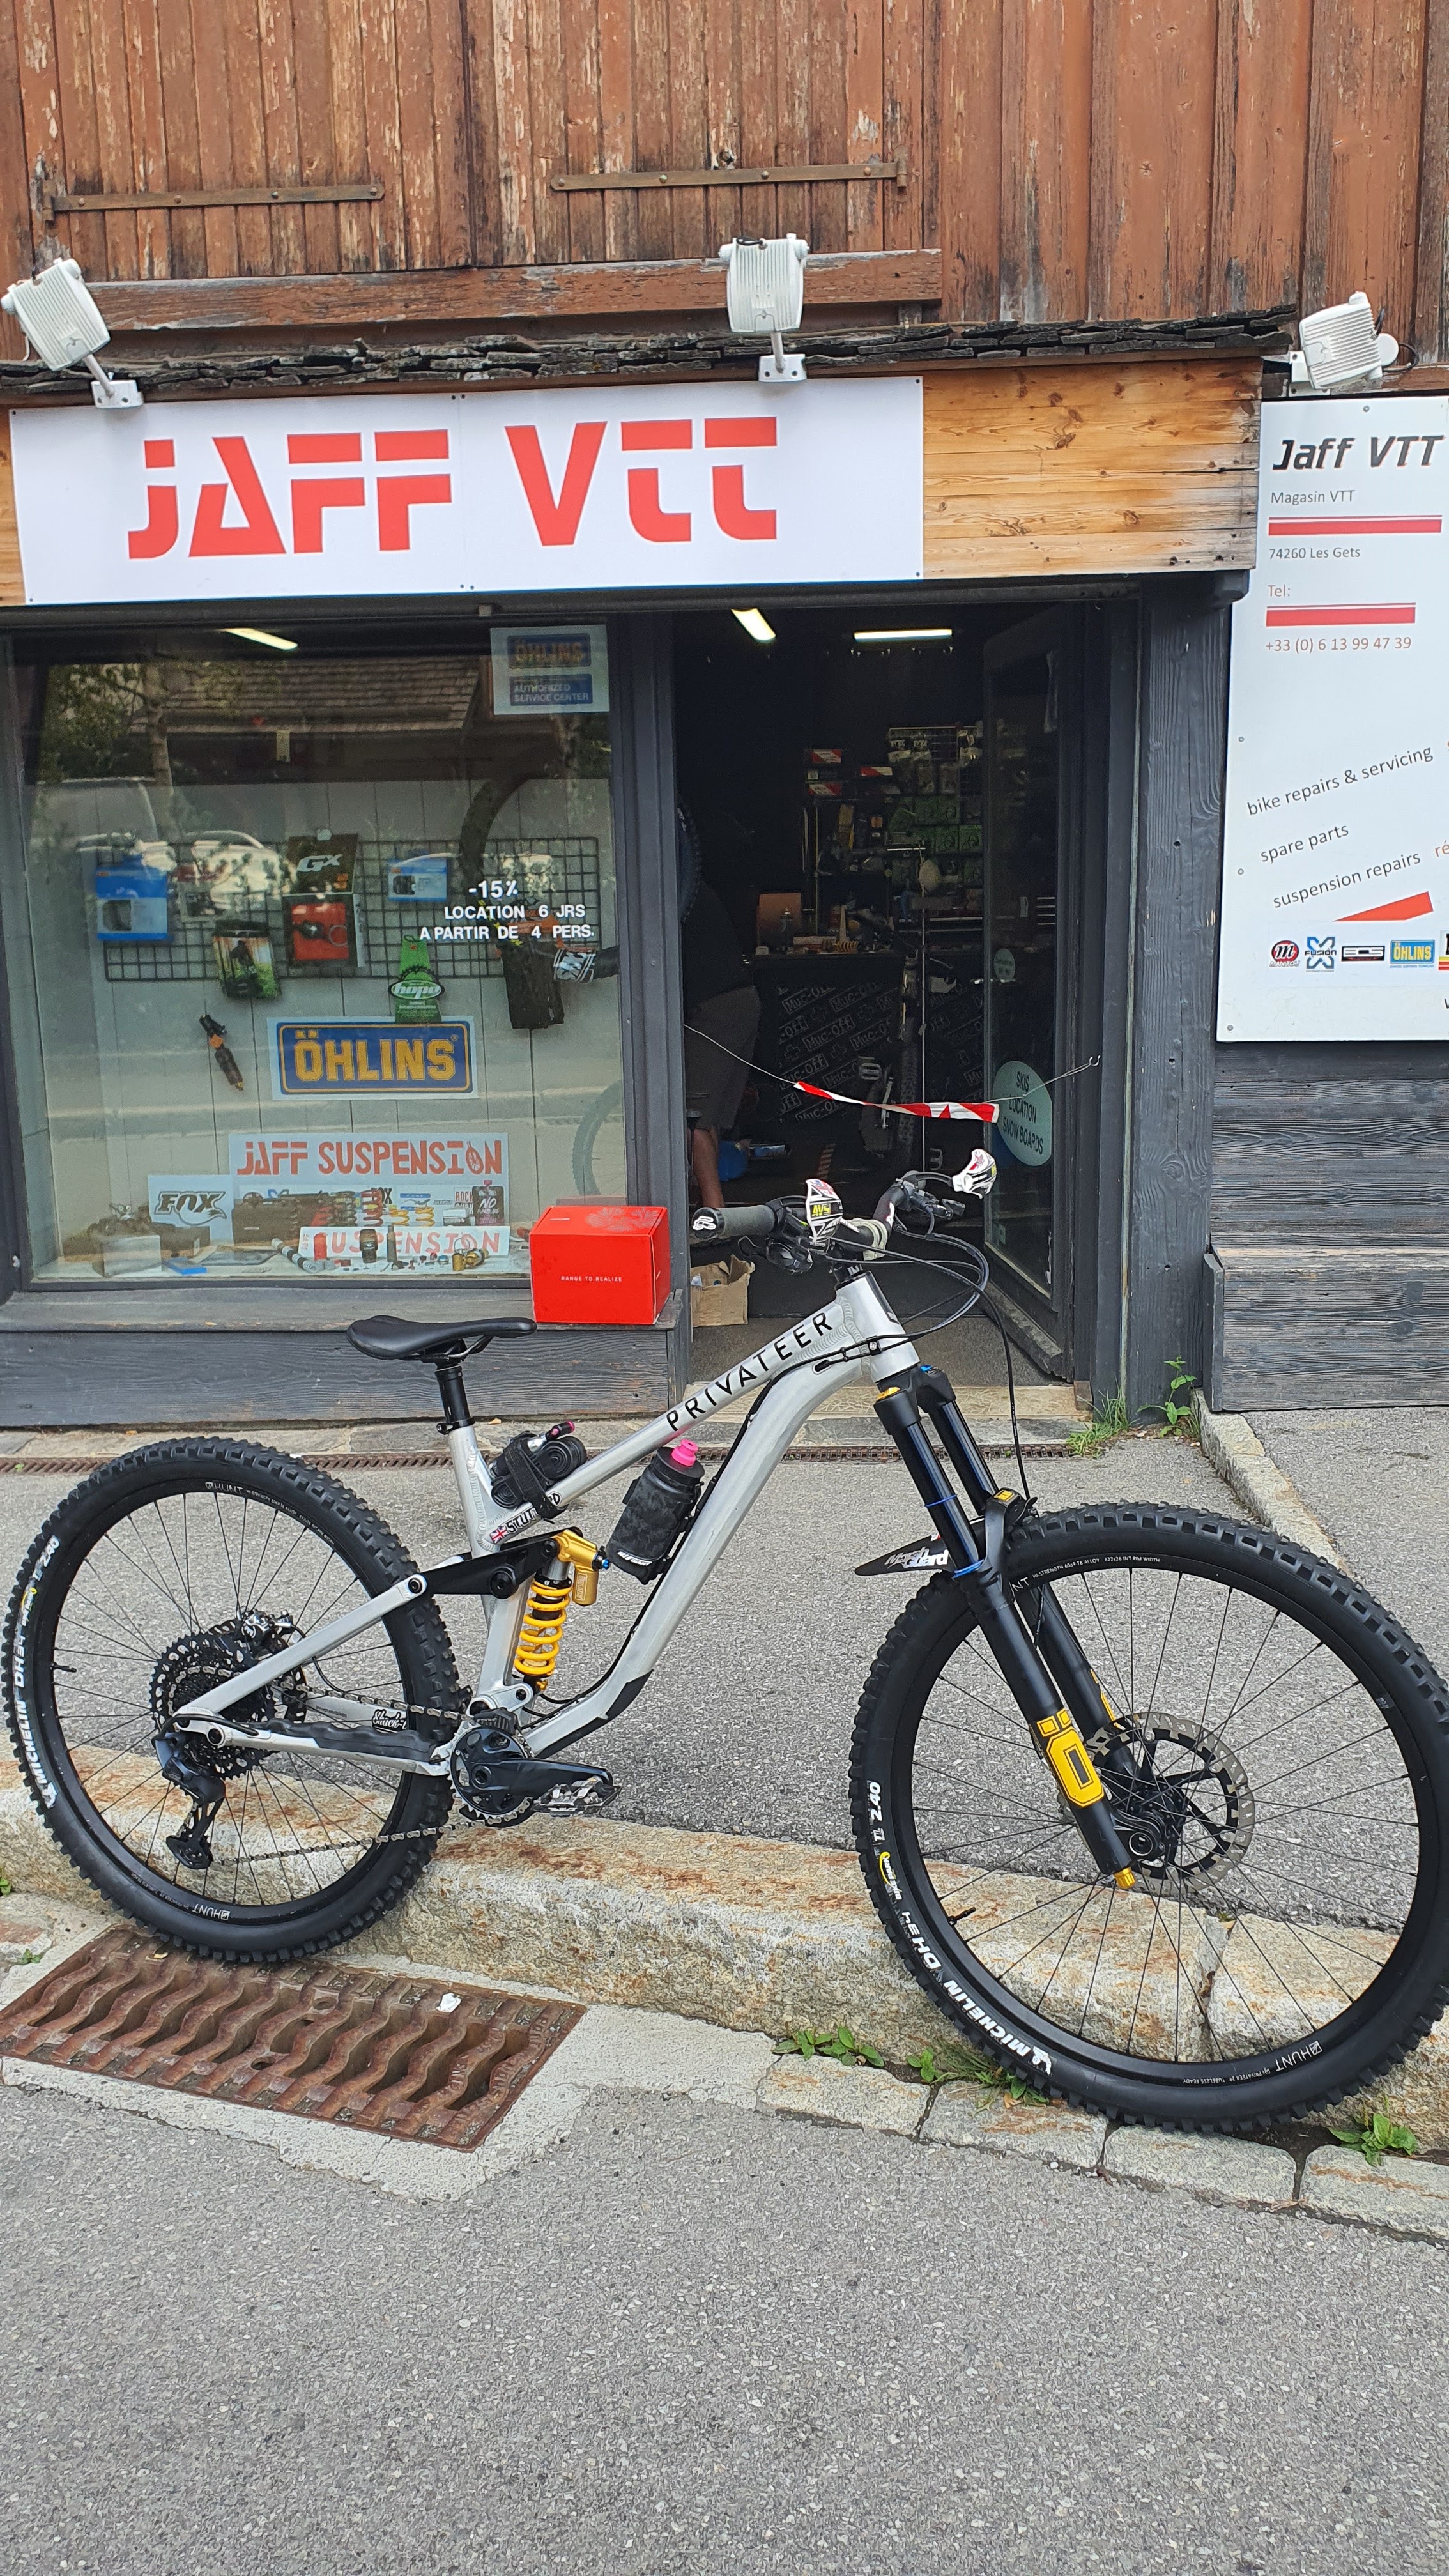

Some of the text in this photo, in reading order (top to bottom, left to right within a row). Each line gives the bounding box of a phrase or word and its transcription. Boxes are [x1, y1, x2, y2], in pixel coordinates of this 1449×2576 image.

[1272, 434, 1445, 471] Jaff VTT
[504, 416, 777, 546] VTT
[1271, 489, 1356, 506] Magasin VTT
[1269, 546, 1360, 560] 74260 Les Gets
[1268, 585, 1291, 597] Tel:
[1266, 636, 1411, 654] +33 (0) 6 13 99 47 39
[514, 684, 571, 693] AUTHORIZED
[514, 693, 589, 702] SERVICE CENTER
[1247, 747, 1434, 816] bike repairs & servicing
[1261, 823, 1349, 864] spare parts
[297, 854, 343, 872] GX
[468, 880, 518, 898] -15%
[1273, 852, 1421, 908] suspension repairs
[444, 904, 586, 920] LOCATION 6 JRS
[420, 924, 595, 940] A PARTIR DE 4 PERS.
[1393, 942, 1432, 960] ÖHLINS
[394, 983, 441, 999] hope
[294, 1029, 456, 1081] ÖHLINS
[1016, 1071, 1030, 1092] SKIS
[1008, 1096, 1038, 1124] LOCATION
[1002, 1118, 1044, 1155] SNOW BOARDS
[237, 1140, 502, 1176] JAFF SUSPENSION
[154, 1191, 226, 1219] FOX
[811, 1203, 831, 1217] AVS
[666, 1312, 833, 1432] PRIVATEER
[214, 1482, 243, 1495] HUNT
[39, 1534, 60, 1568] 2.40
[901, 1549, 949, 1568] Guard
[16, 1699, 48, 1784] MICHELIN
[870, 1781, 882, 1821] 2.40
[884, 1856, 903, 1900] BIKE PARK
[192, 1903, 222, 1919] HUNT
[942, 1979, 1031, 2057] MICHELIN
[1275, 2046, 1312, 2072] HUNT
[1200, 2076, 1225, 2085] TUBELESS
[1236, 2071, 1262, 2082] PRIVATEER
